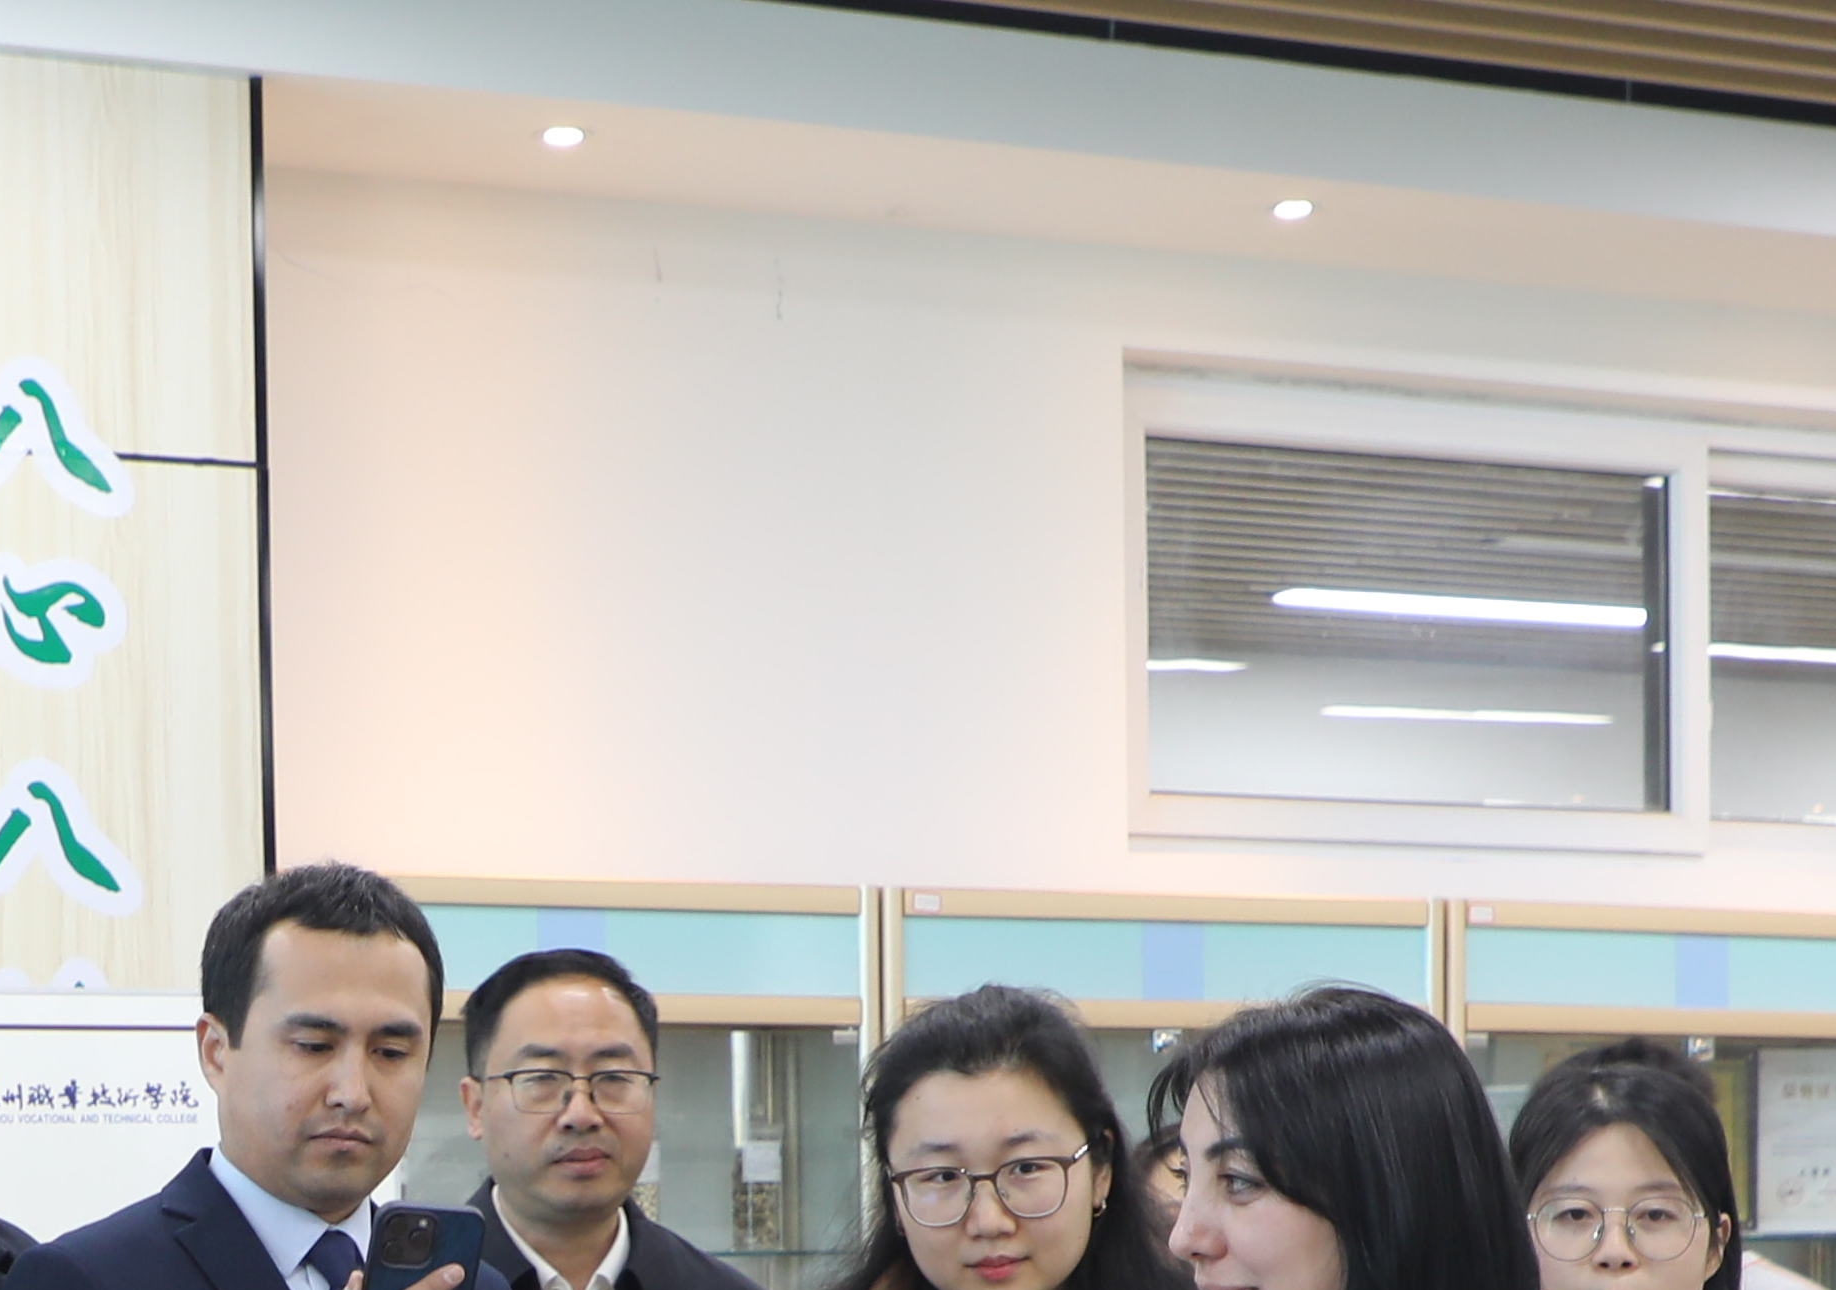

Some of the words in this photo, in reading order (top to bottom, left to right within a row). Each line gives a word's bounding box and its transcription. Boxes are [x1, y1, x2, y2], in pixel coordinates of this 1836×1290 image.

[17, 1113, 77, 1124] VOCATIONAL
[80, 1113, 100, 1124] AND
[103, 1113, 154, 1124] TECHNICAL
[157, 1113, 199, 1124] COLLEGE
